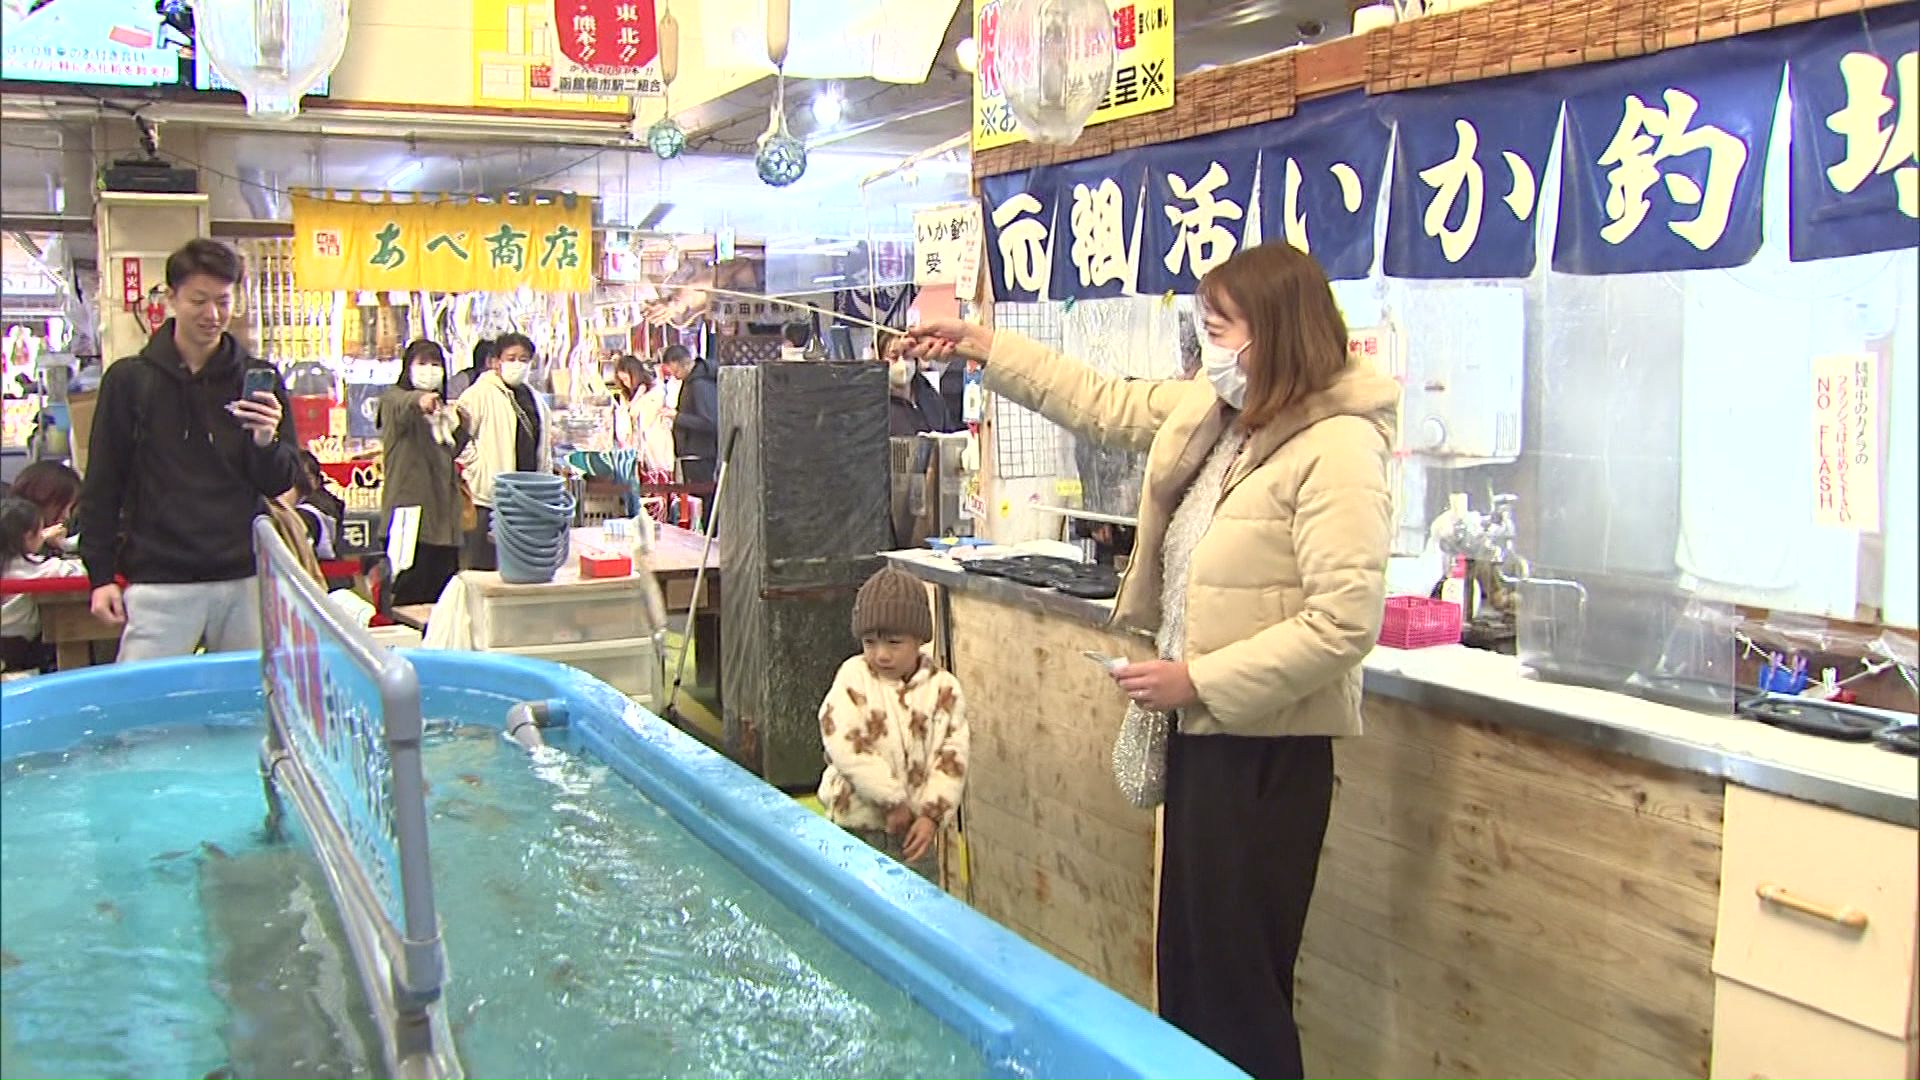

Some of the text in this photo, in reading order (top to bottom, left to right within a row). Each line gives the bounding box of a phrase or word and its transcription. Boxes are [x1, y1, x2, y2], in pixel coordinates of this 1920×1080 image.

[369, 222, 580, 273] あべ商店
[1816, 376, 1833, 511] NO FLASH
